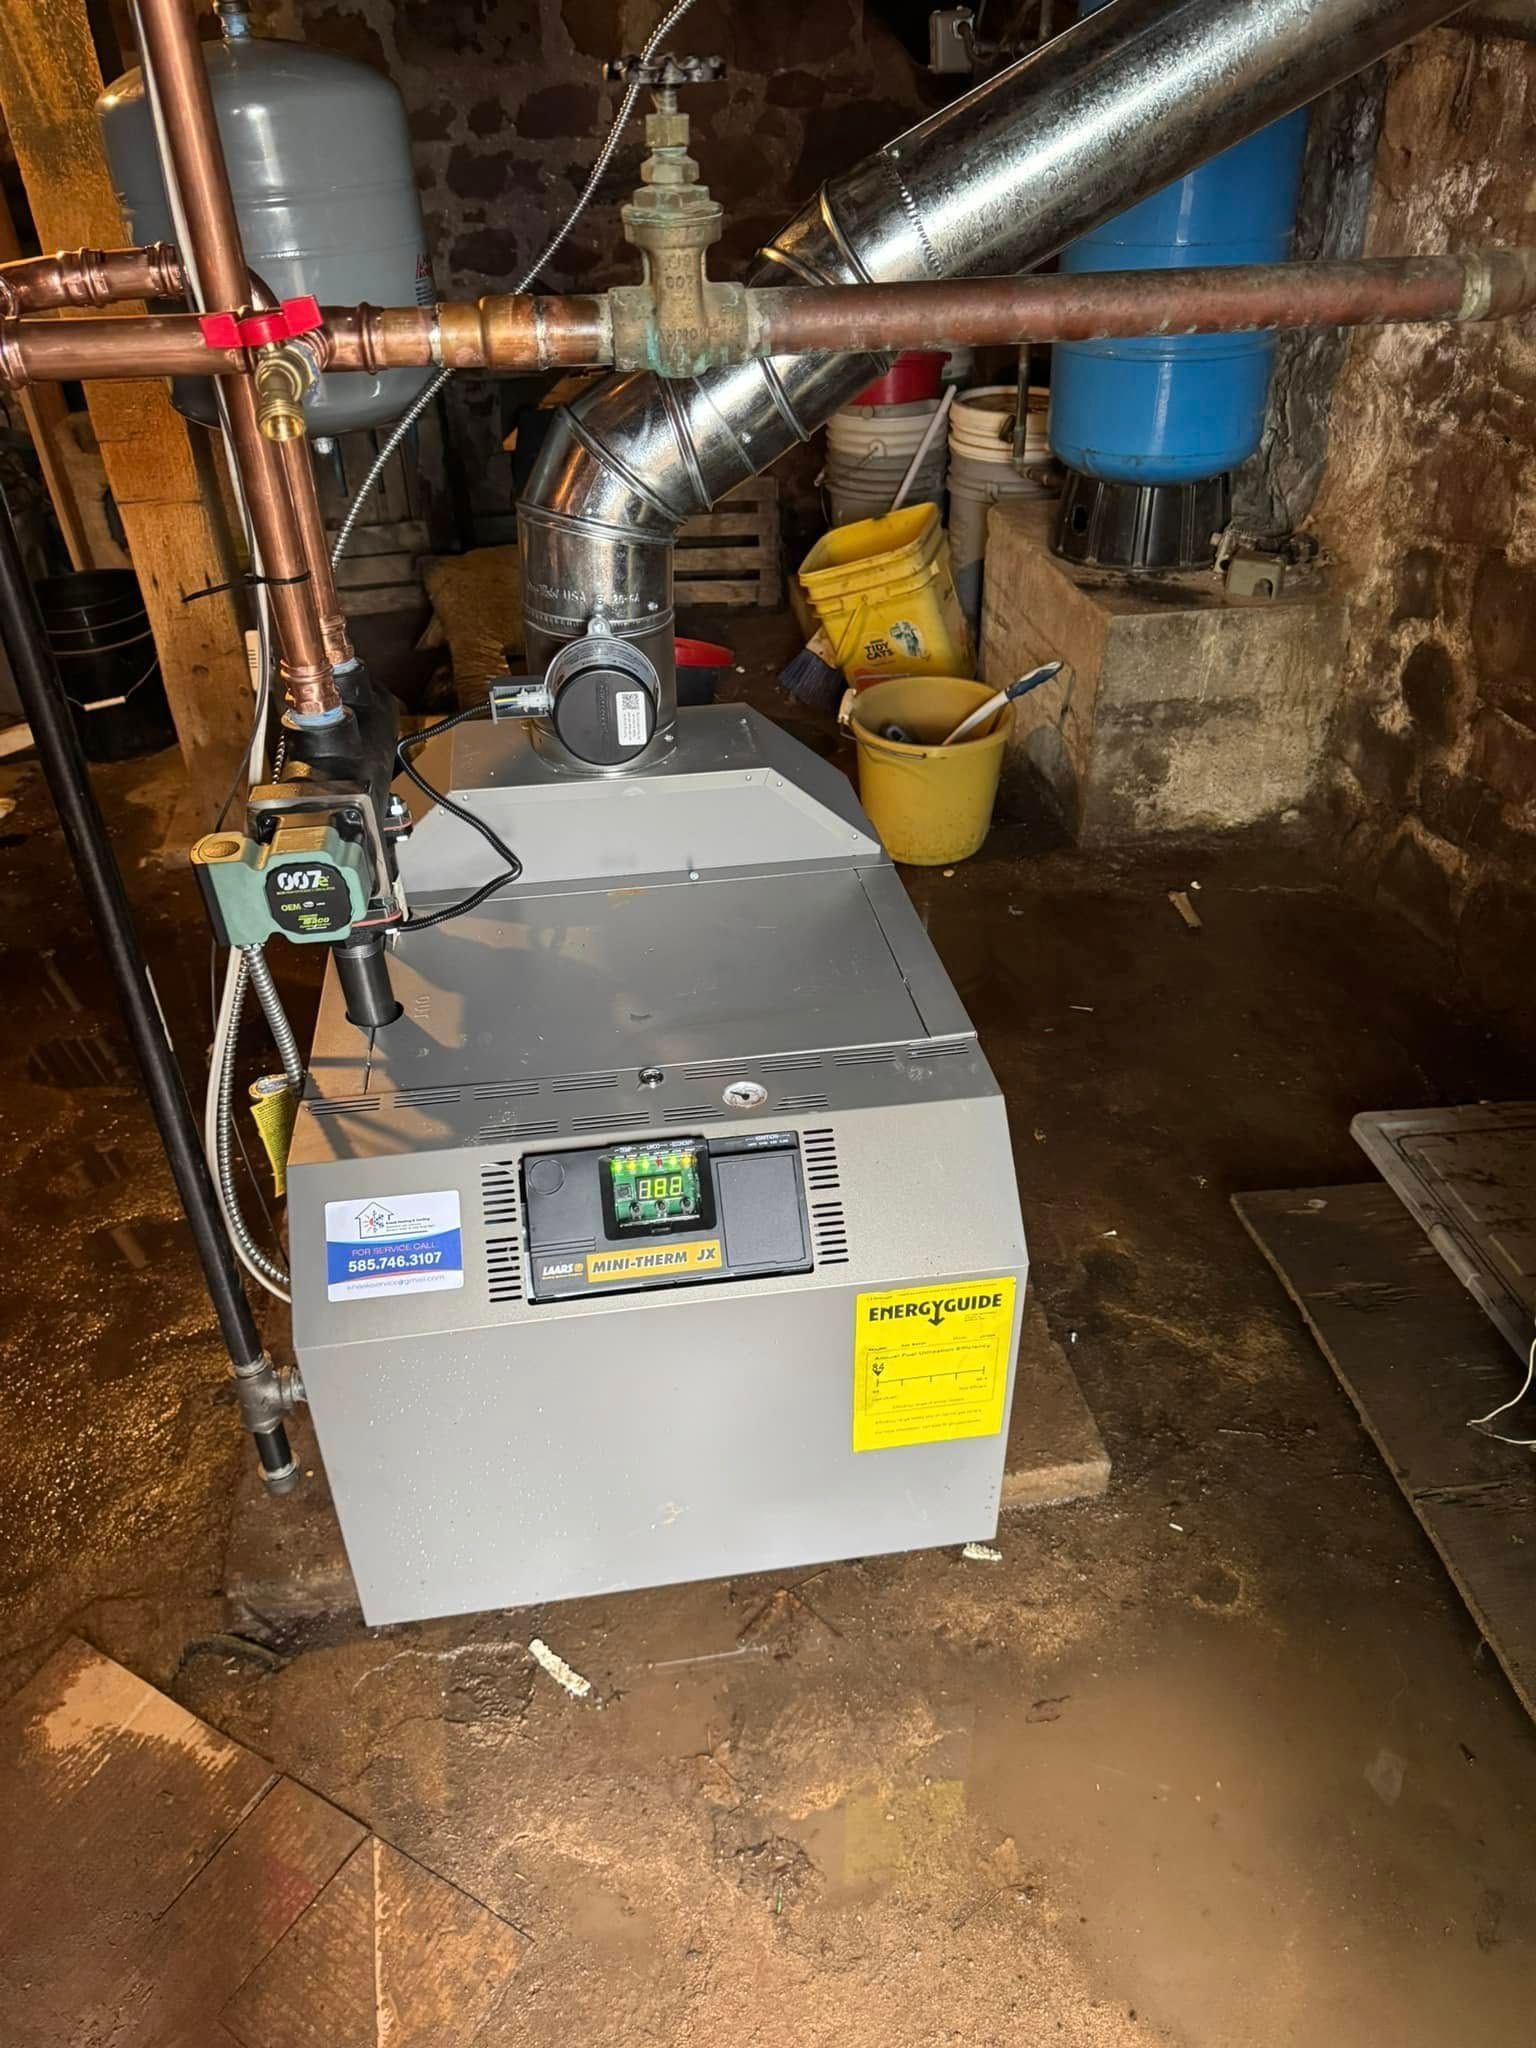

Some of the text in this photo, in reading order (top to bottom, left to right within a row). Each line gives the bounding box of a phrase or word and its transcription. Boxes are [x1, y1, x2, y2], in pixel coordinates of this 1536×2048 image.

[864, 641, 888, 652] TIDY
[866, 648, 894, 660] CATS
[280, 903, 302, 912] OEM
[351, 1248, 371, 1256] FOR
[373, 1245, 411, 1255] SERVICE
[348, 1252, 442, 1272] 585.746.3107
[592, 1248, 717, 1273] MINI-THERM JX
[542, 1263, 574, 1276] LAARS
[869, 1293, 1002, 1324] ENERGYGUIDE
